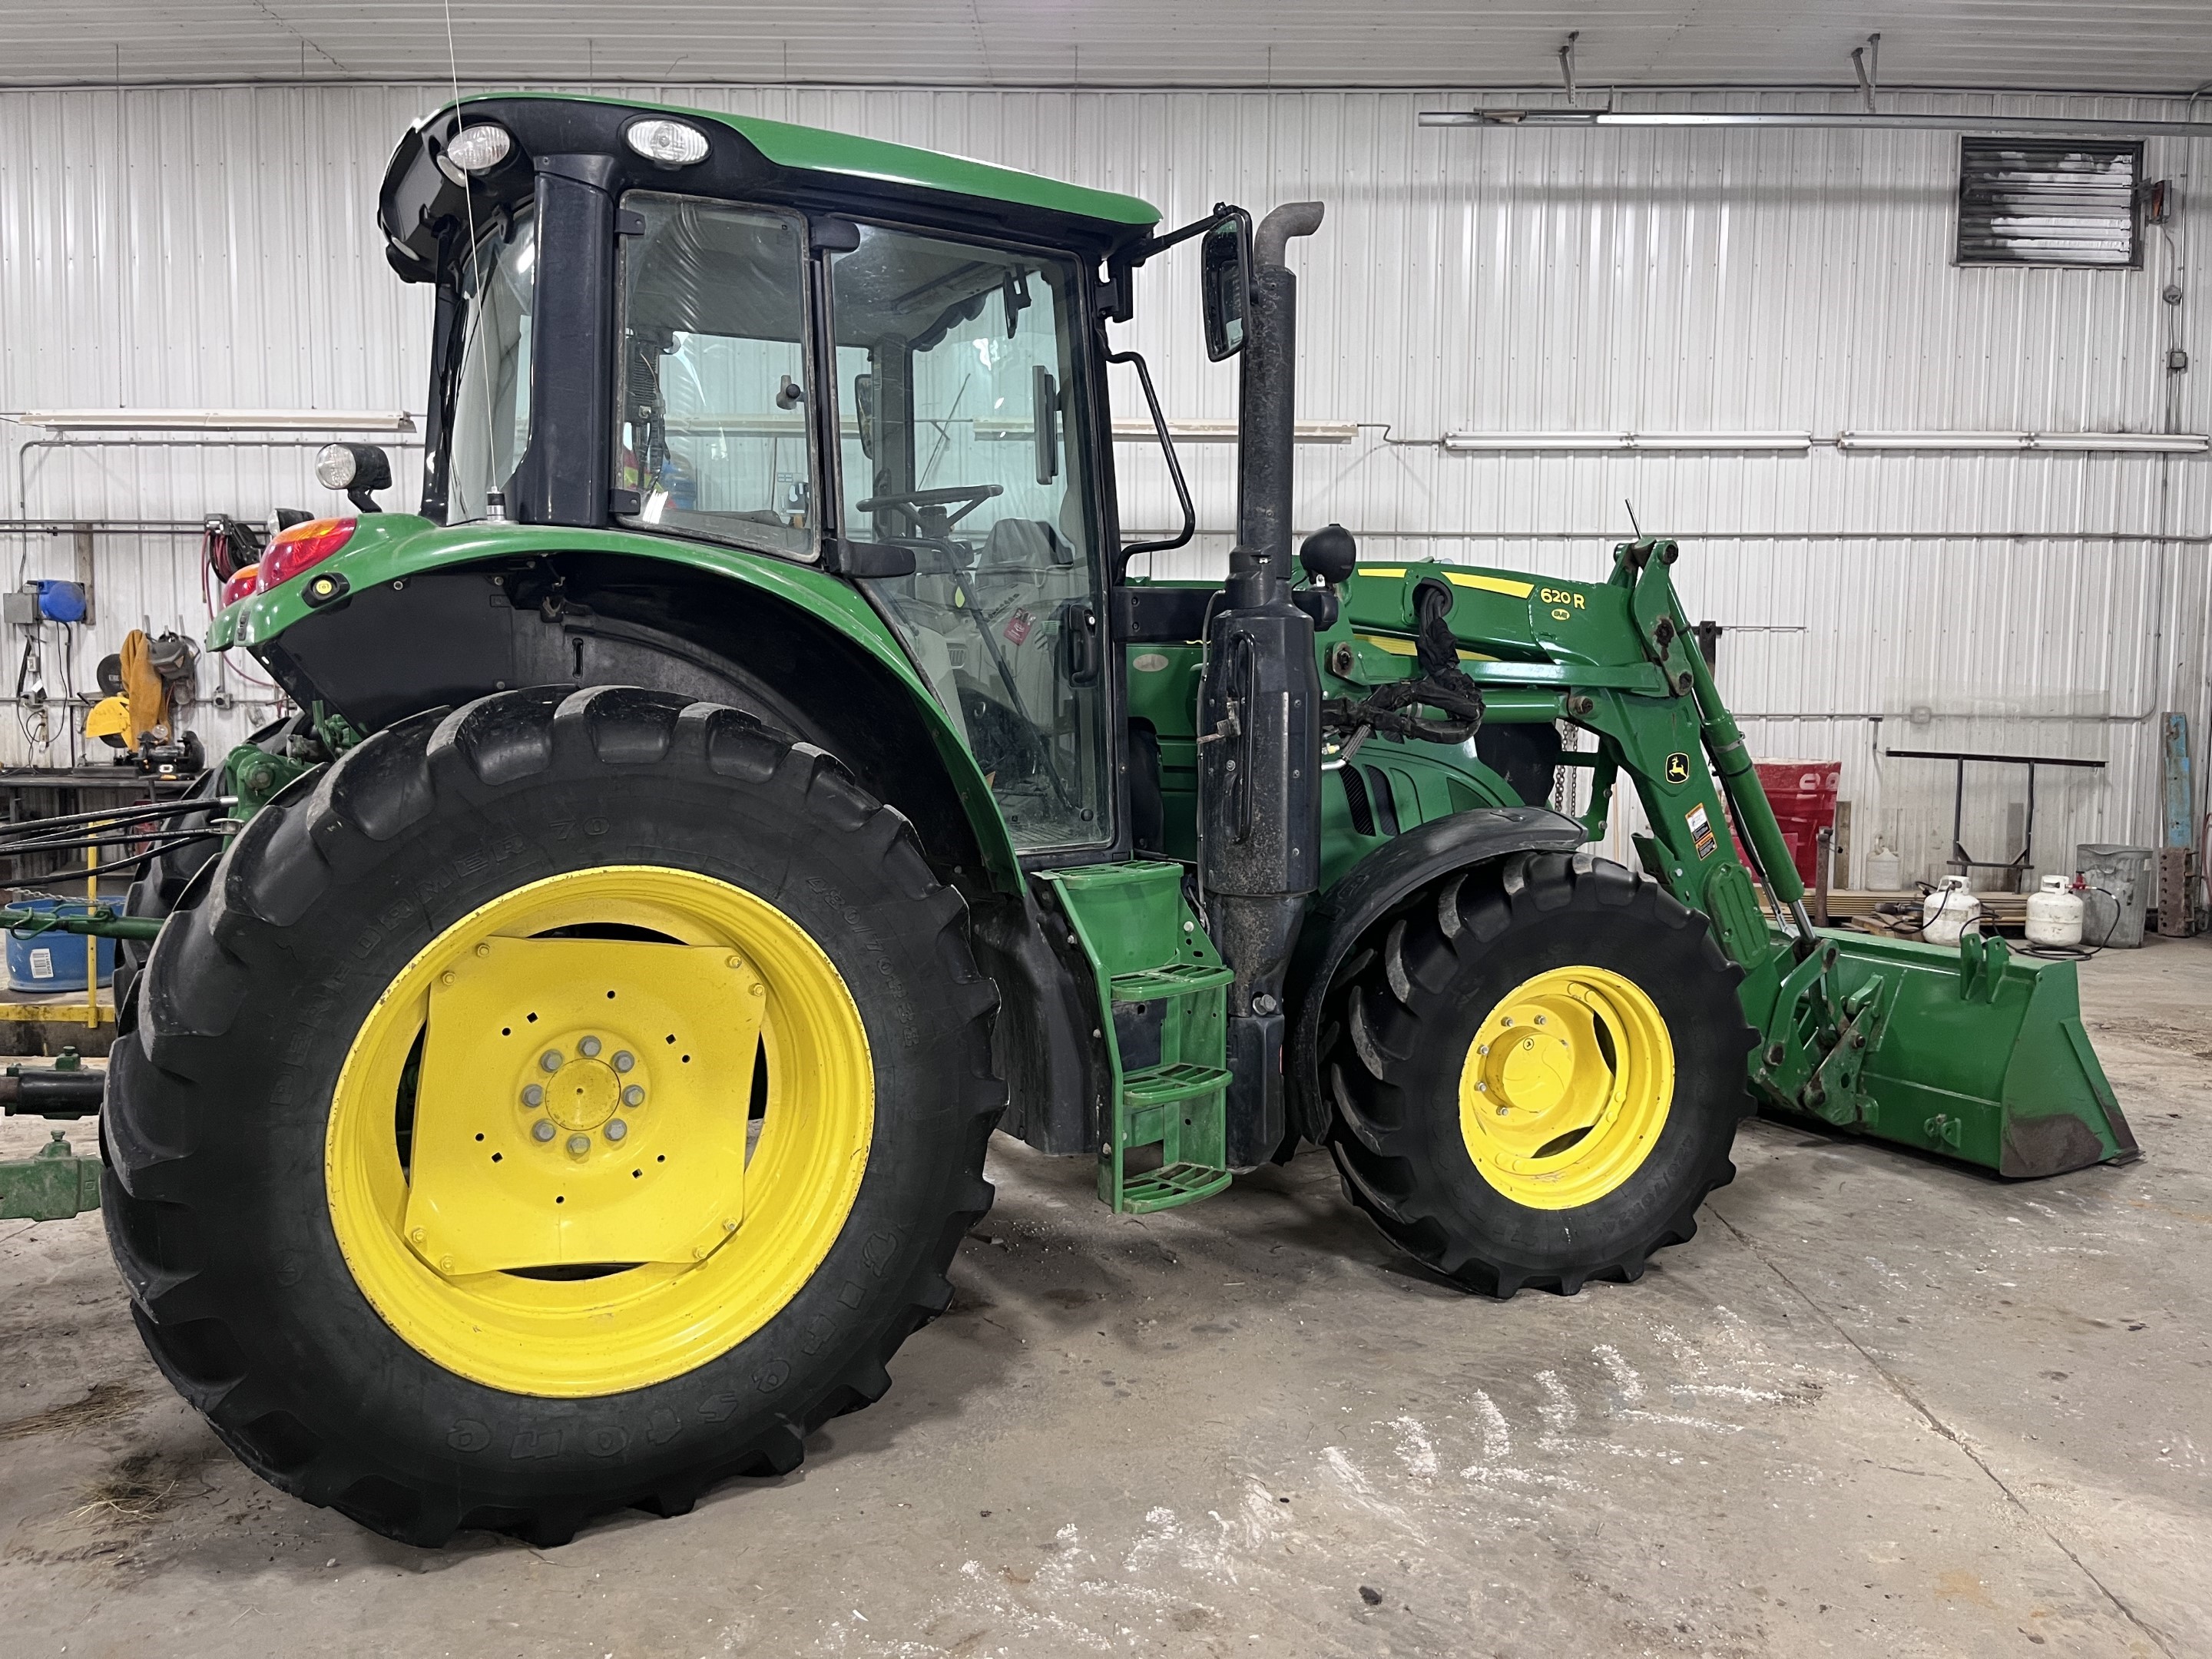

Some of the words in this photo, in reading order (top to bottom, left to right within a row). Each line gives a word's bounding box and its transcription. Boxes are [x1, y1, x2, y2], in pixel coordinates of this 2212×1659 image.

[1540, 588, 1571, 604] 620
[1573, 593, 1585, 610] R
[270, 833, 528, 1105] PERFORMER
[548, 816, 611, 841] 70
